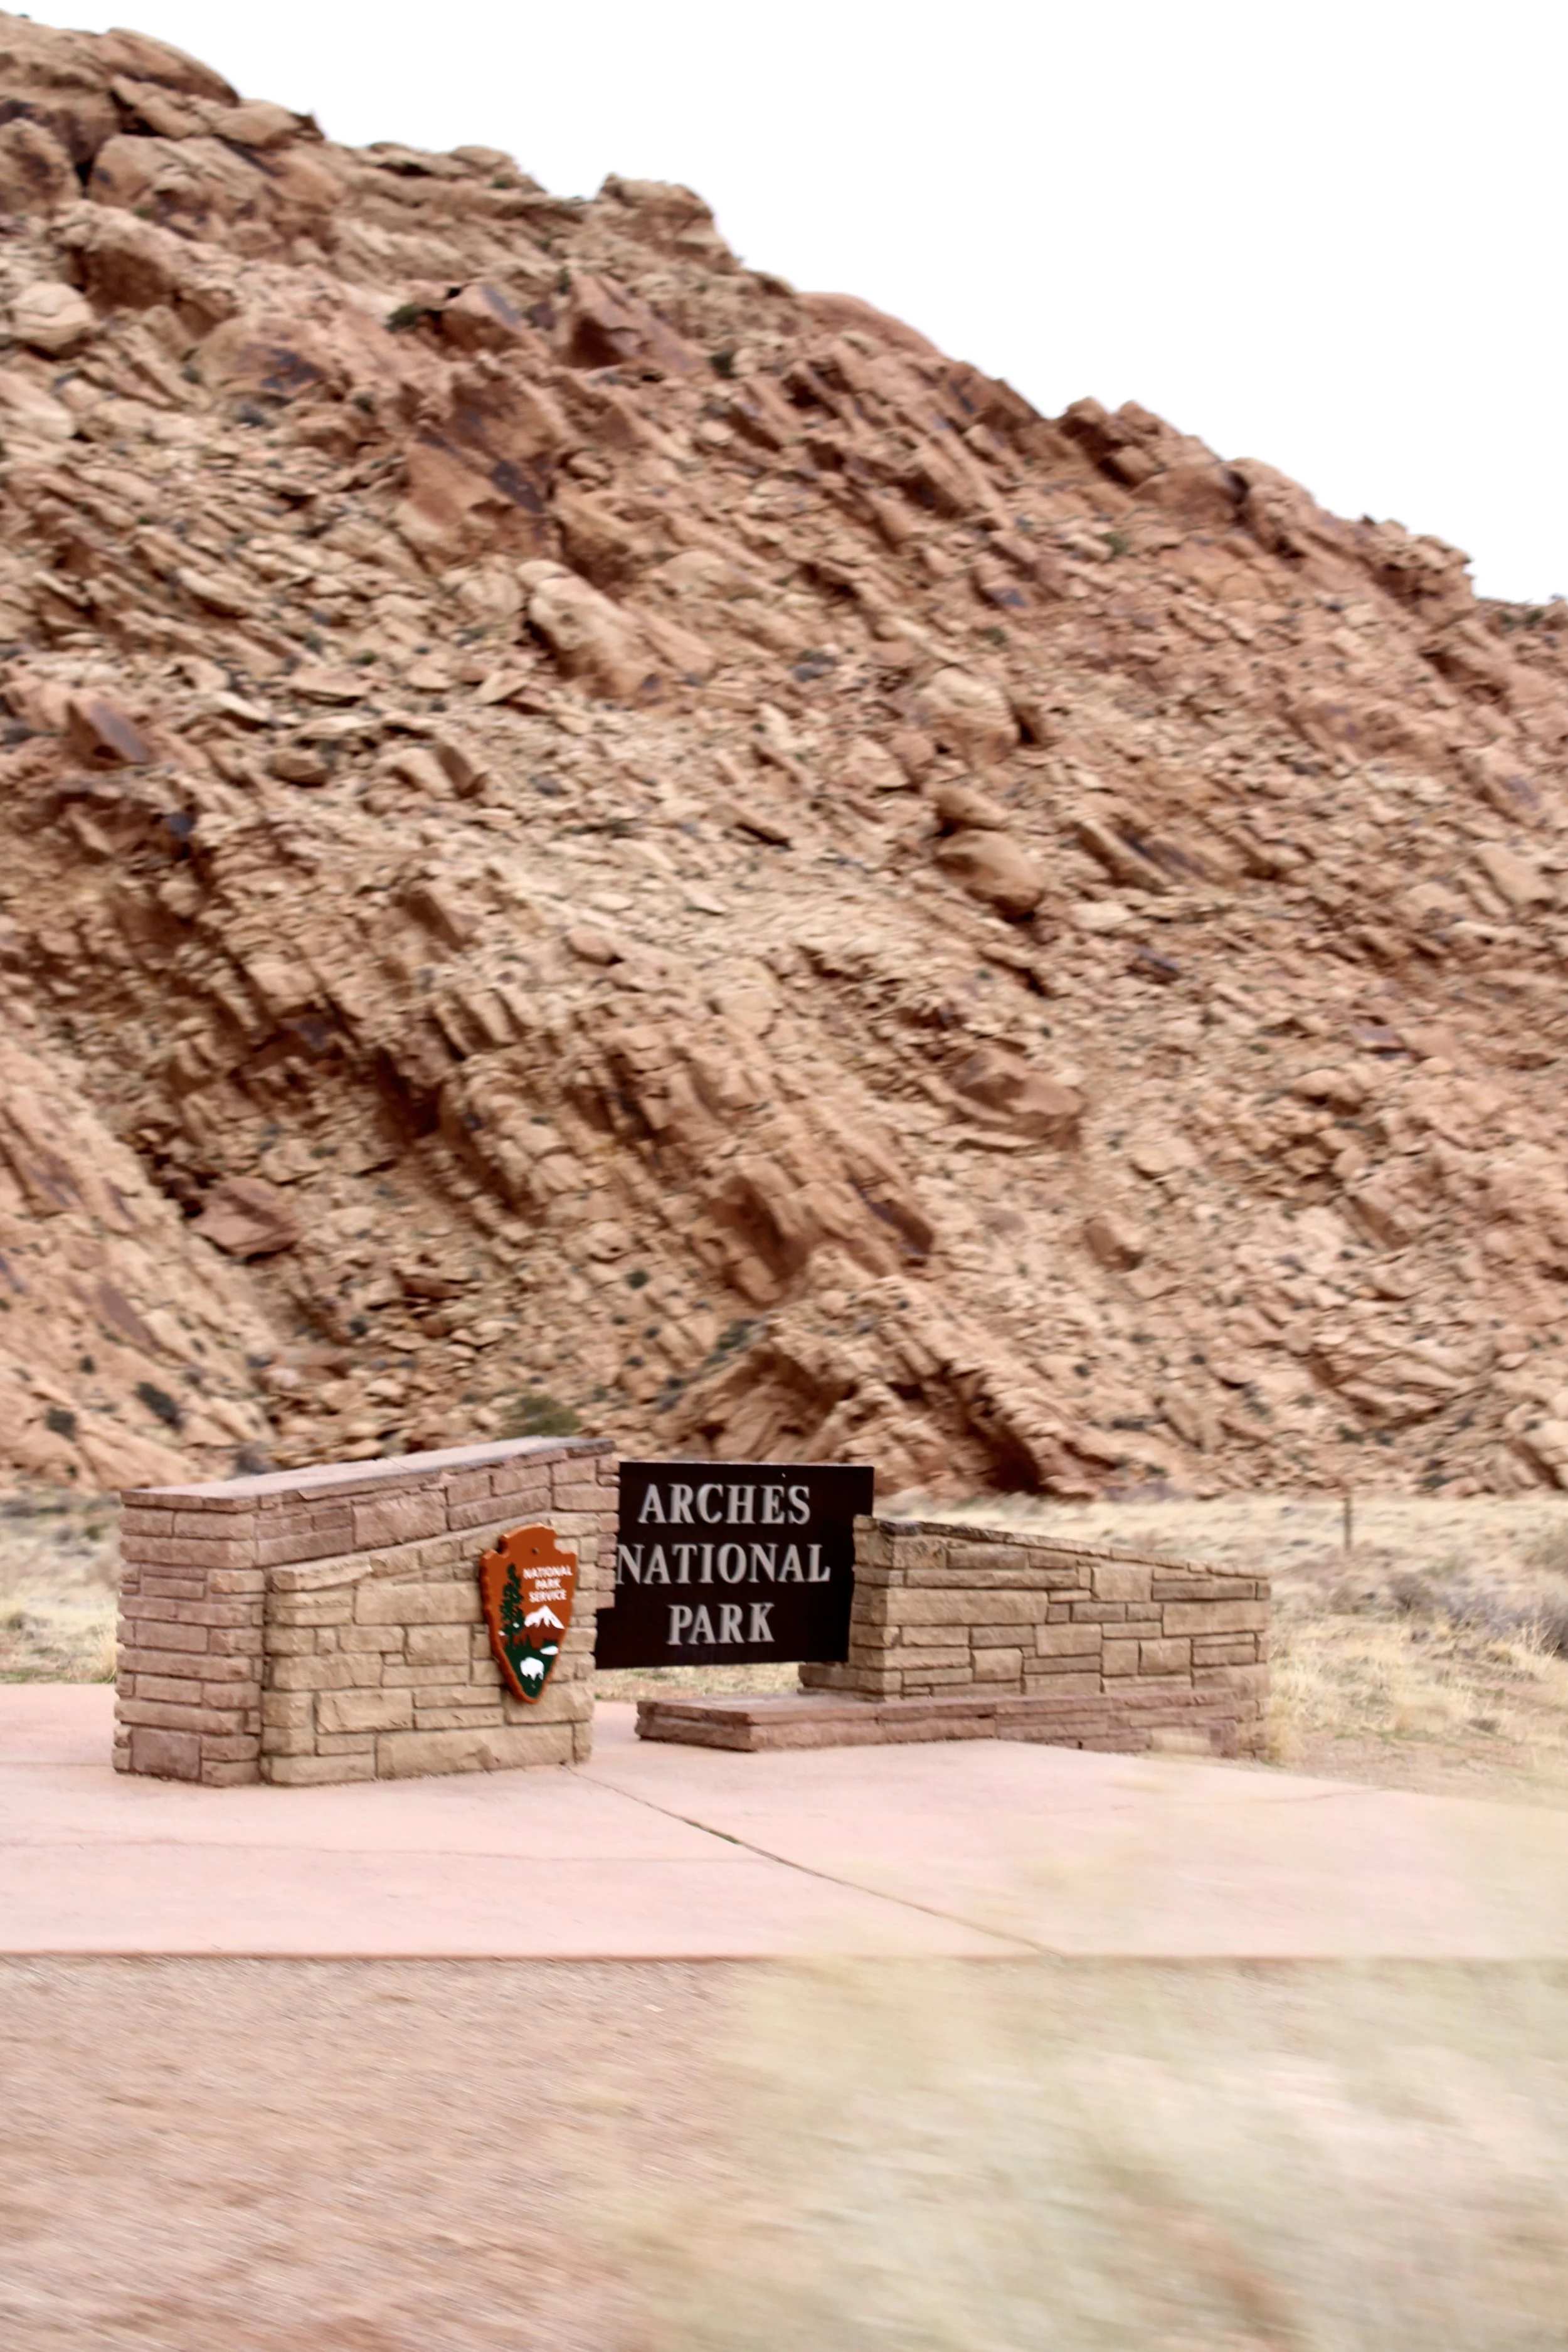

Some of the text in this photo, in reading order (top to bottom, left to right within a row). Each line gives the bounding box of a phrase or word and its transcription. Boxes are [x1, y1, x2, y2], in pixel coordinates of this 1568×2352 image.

[638, 1483, 810, 1525] ARCHES
[523, 1565, 573, 1579] NATIONAL
[616, 1543, 830, 1585] NATIONAL
[529, 1589, 567, 1602] SERVICE
[535, 1578, 561, 1590] PARK
[666, 1602, 775, 1645] PARK
